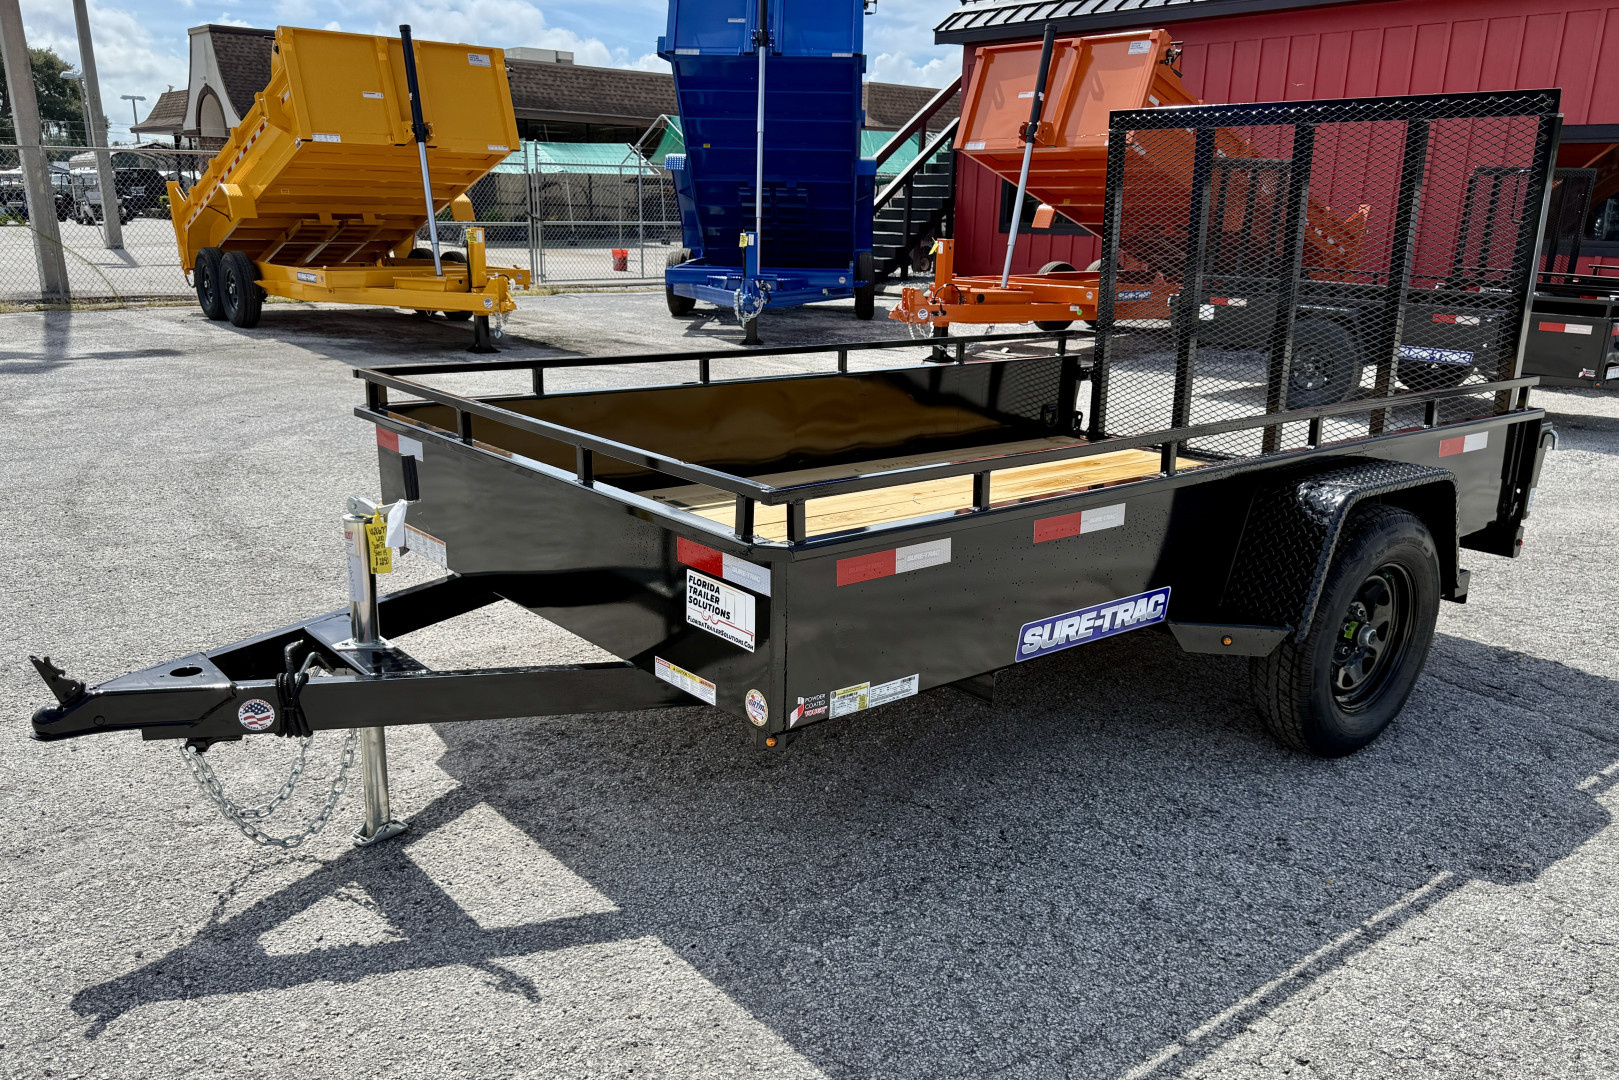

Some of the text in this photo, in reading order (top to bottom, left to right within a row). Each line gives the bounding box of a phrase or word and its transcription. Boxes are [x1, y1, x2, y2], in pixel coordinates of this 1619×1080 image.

[906, 549, 941, 562] SURE-TRAC
[688, 575, 720, 595] FLORIDA
[688, 586, 720, 605] TRAILER
[688, 595, 731, 620] SOLUTIONS
[1021, 593, 1166, 655] SURE-TRAC
[805, 693, 826, 703] POWDER
[805, 699, 826, 709] COATED
